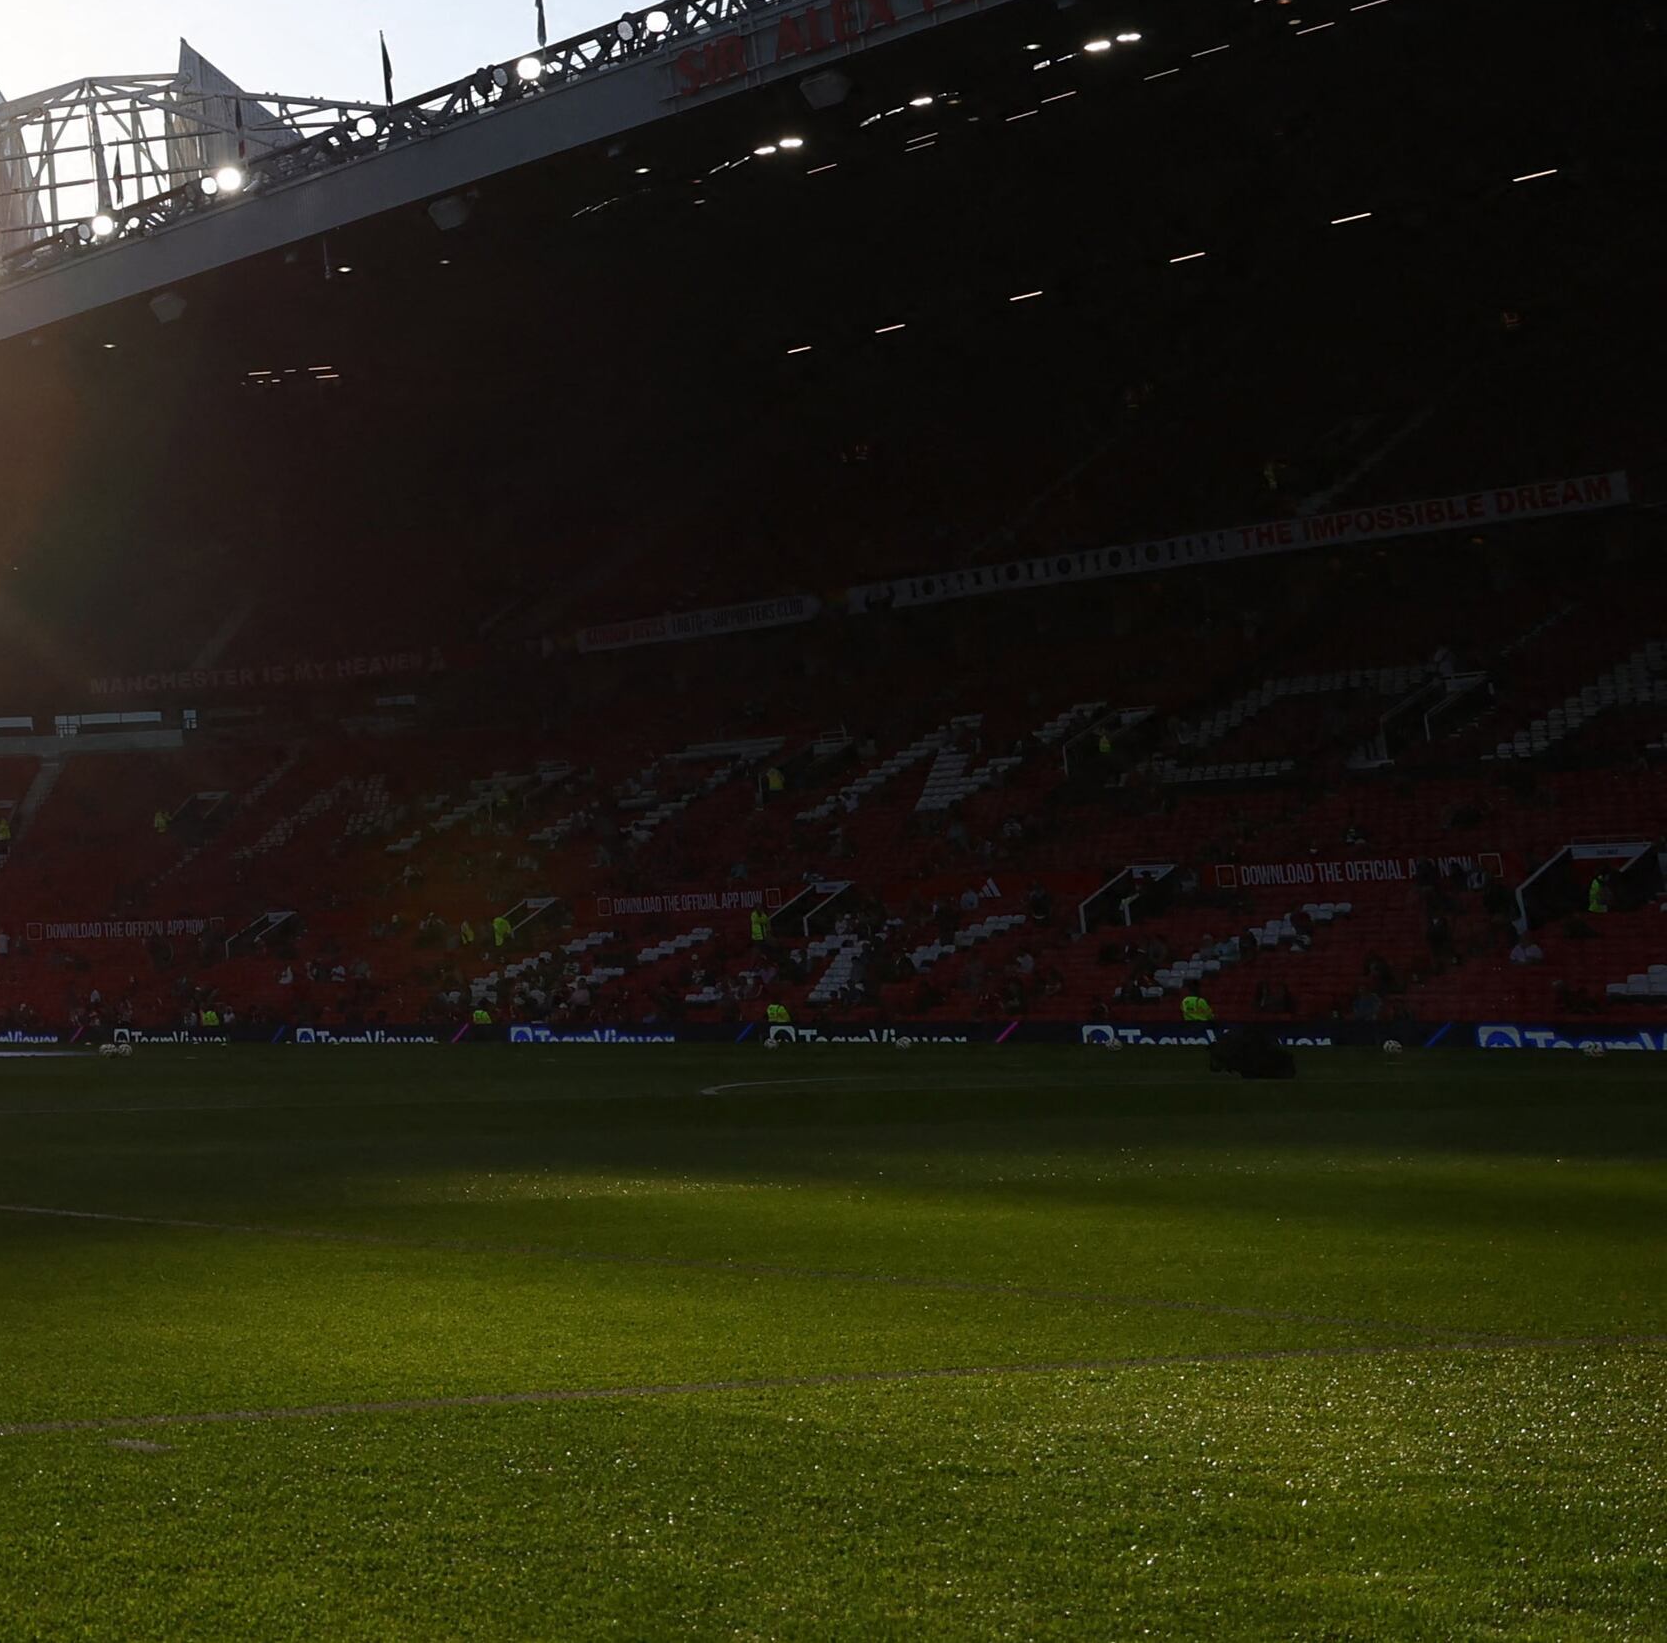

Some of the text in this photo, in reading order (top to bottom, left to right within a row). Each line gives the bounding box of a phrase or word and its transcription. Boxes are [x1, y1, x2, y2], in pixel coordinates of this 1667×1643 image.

[675, 34, 747, 97] SIR
[1239, 474, 1613, 551] THE IMPOSSIBLE DREAM
[90, 667, 256, 695] MANCHESTER
[263, 666, 286, 683] IS
[294, 662, 327, 682] MY
[1240, 864, 1315, 886] DOWNLOAD
[1316, 862, 1344, 884] THE
[1345, 859, 1406, 883] OFFICIAL
[613, 890, 763, 914] DOWNLOAD THE OFFICIAL APP NOW
[46, 922, 102, 939] DOWNLOAD
[104, 922, 125, 938] THE
